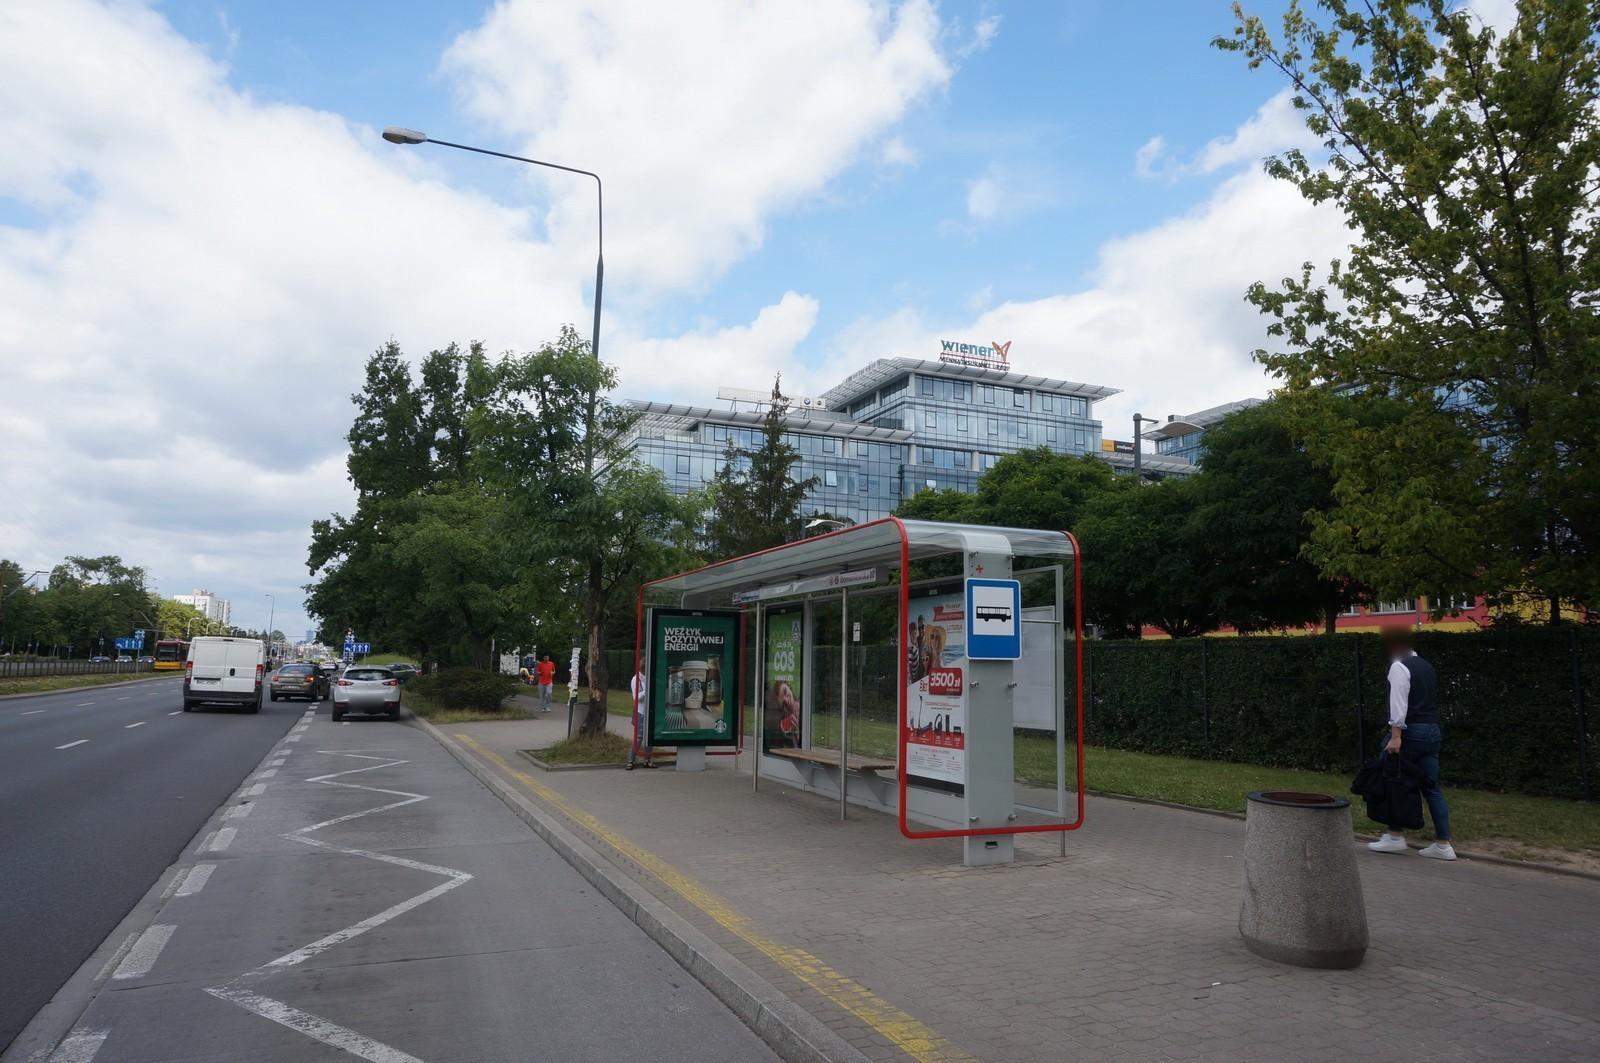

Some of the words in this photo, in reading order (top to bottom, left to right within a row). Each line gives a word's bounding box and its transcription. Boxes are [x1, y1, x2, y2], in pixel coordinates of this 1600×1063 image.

[941, 340, 993, 357] wiener
[664, 635, 724, 645] POZYTYWNEJ
[664, 643, 699, 652] ENERGII
[930, 672, 954, 687] 3500
